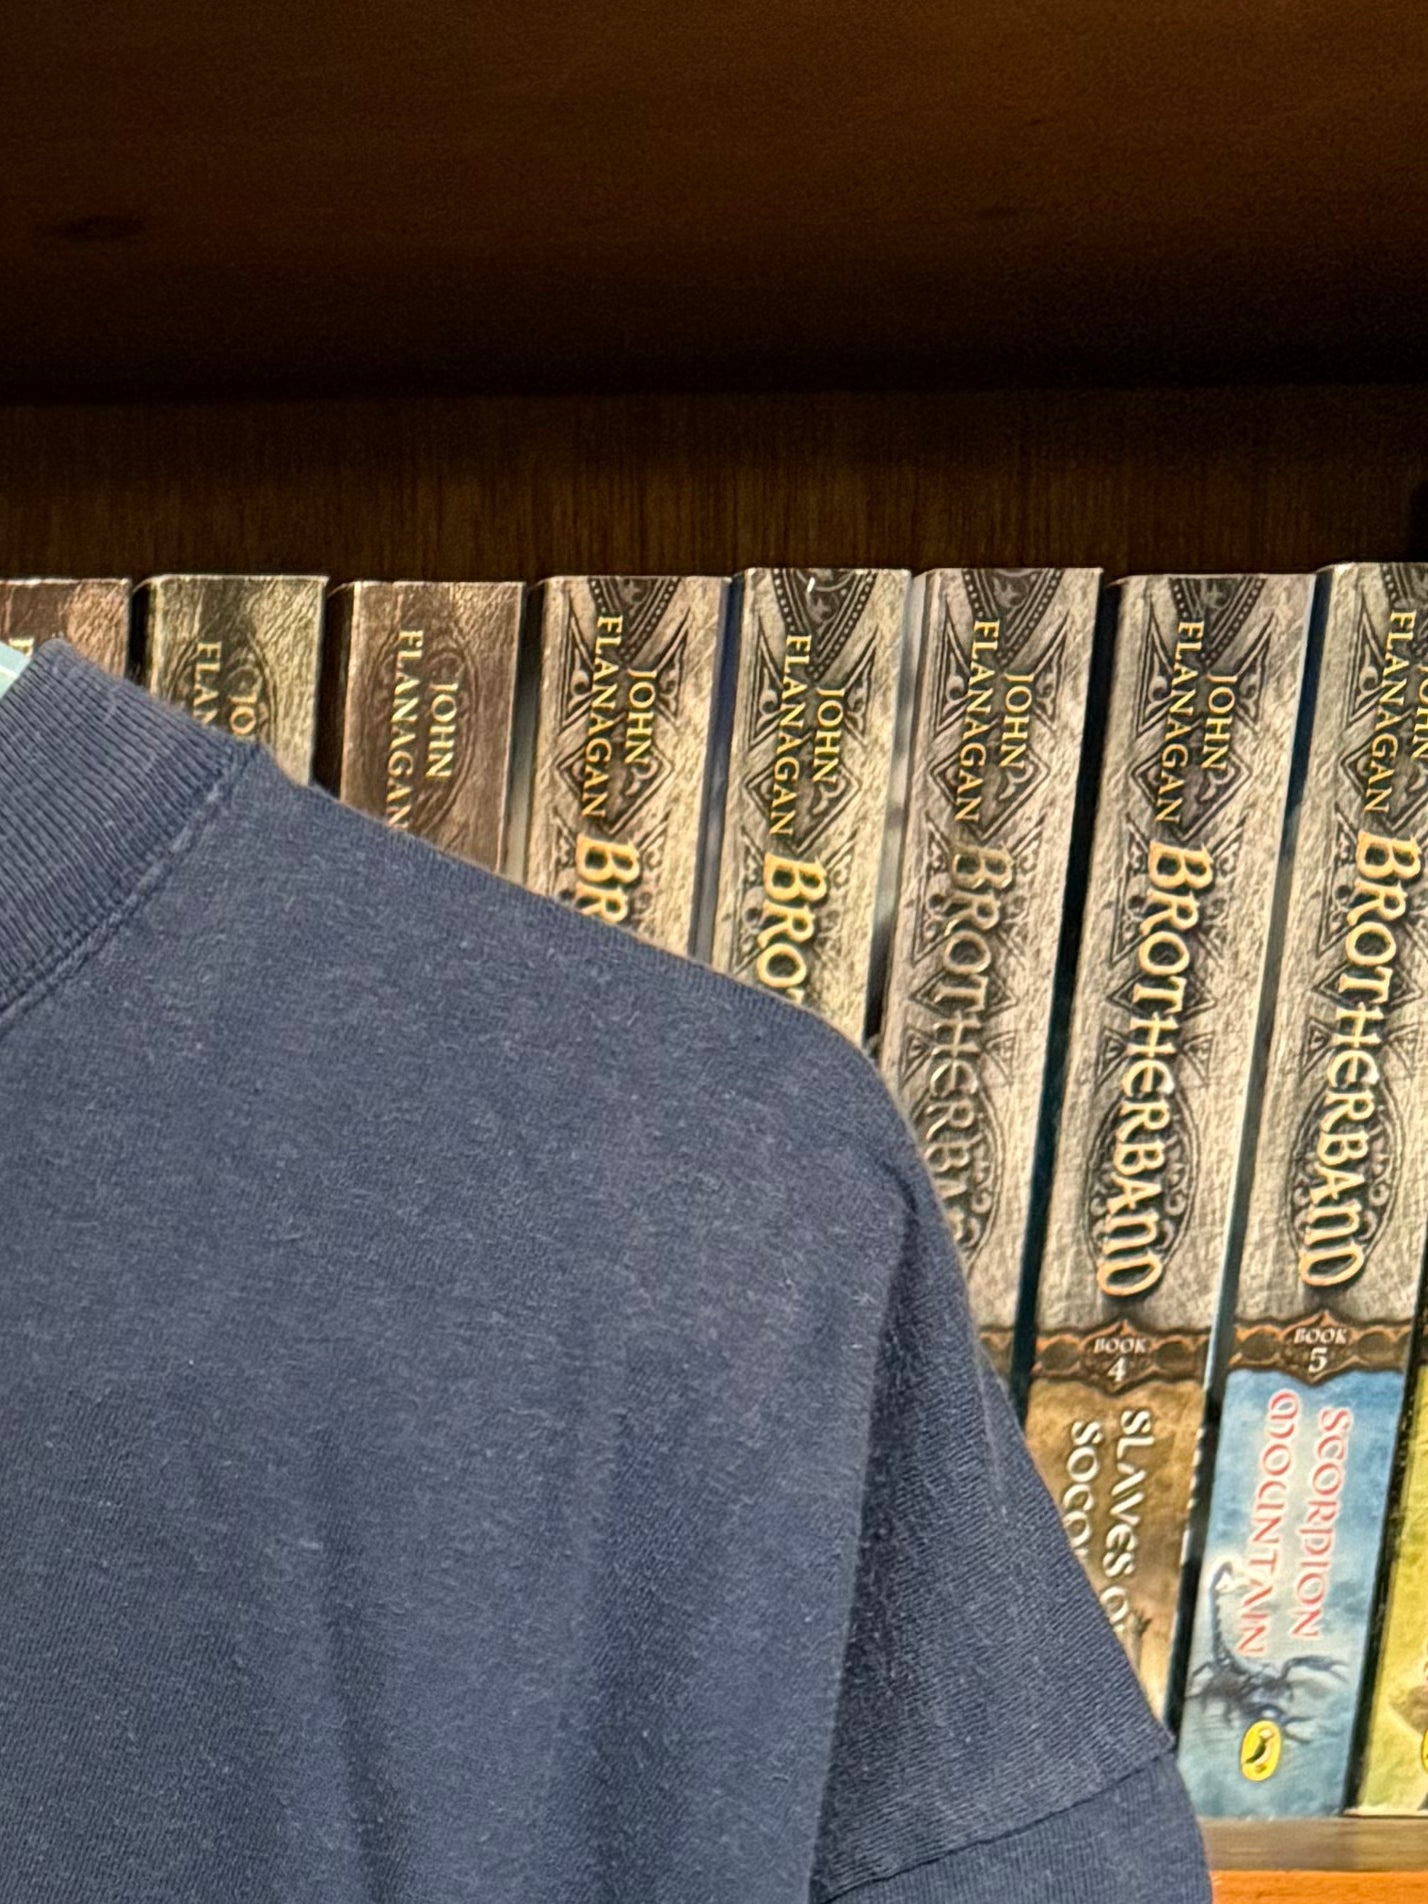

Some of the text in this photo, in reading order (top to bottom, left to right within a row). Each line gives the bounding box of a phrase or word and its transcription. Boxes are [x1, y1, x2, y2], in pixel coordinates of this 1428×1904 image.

[386, 629, 424, 829] FLANAGAN
[425, 682, 459, 779] JOHN
[582, 615, 623, 819] FLANAGAN
[624, 669, 656, 765] JOHN
[769, 635, 811, 835] FLANAGAN
[808, 686, 844, 785] JOHN
[956, 619, 999, 823] FLANAGAN
[999, 675, 1033, 770] JOHN
[1152, 621, 1204, 823] FLANAGAN
[1201, 675, 1237, 772] JOHN
[1364, 610, 1417, 813] FLANAGAN
[1096, 842, 1214, 1298] BROTHERBAND
[1298, 830, 1421, 1289] BROTHERBAND
[1094, 1337, 1147, 1355] BOOK
[1108, 1357, 1128, 1382] 4
[1294, 1329, 1347, 1345] BOOK
[1308, 1348, 1328, 1373] 5
[1103, 1410, 1153, 1579] SLAVES
[1236, 1389, 1300, 1656] MOUNTAIN
[1290, 1406, 1352, 1639] SCORPION
